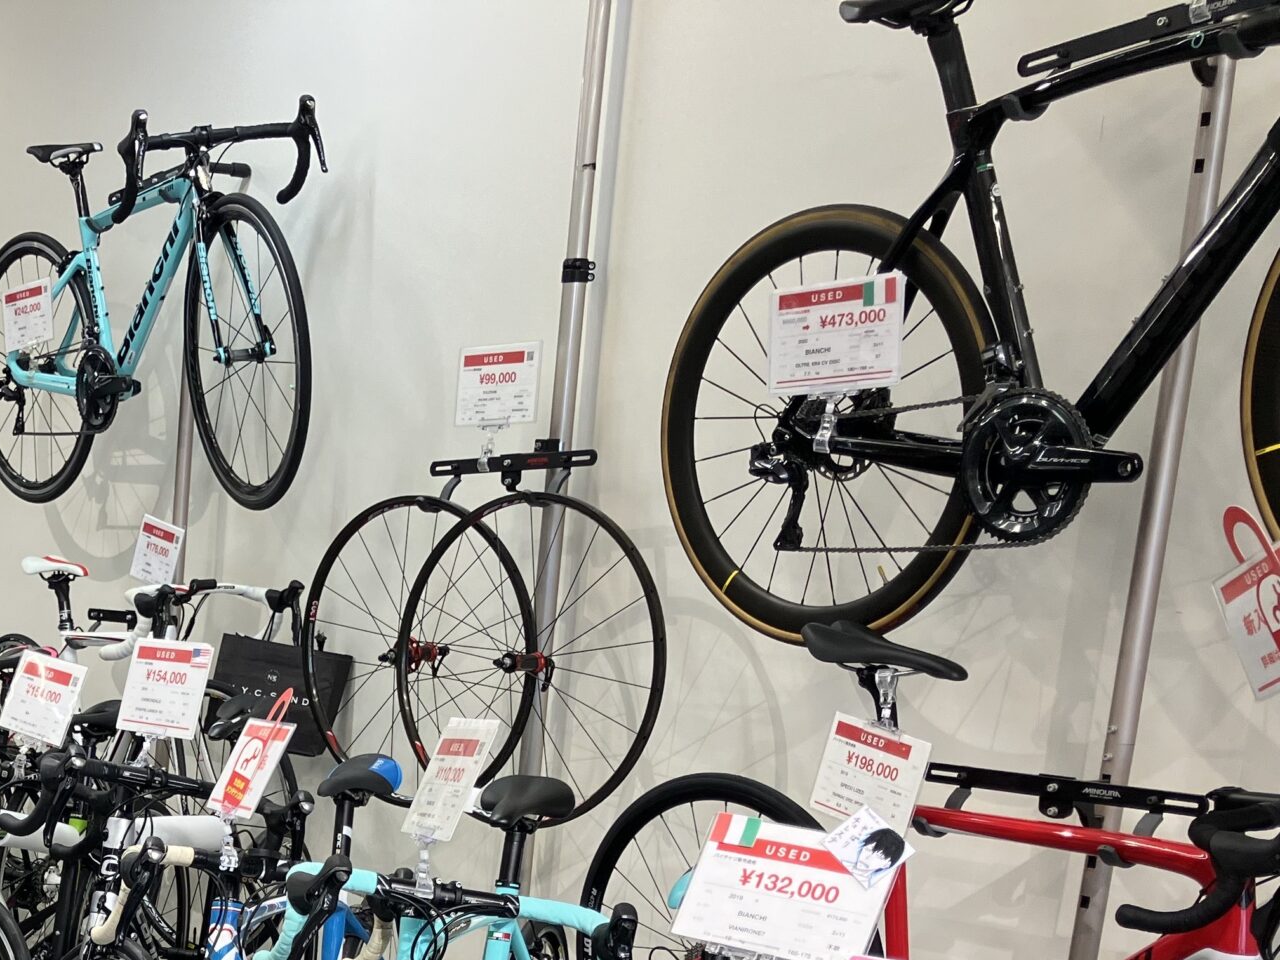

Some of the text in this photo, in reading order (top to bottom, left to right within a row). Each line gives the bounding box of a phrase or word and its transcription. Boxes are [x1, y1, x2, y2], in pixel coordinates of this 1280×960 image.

[811, 290, 843, 302] USED
[819, 308, 886, 329] ¥473,000
[483, 355, 504, 363] USED
[479, 371, 517, 386] ¥99,000
[1243, 562, 1270, 586] USED
[156, 650, 176, 659] USED
[146, 668, 188, 685] ¥154,000
[860, 733, 885, 748] USED
[846, 750, 899, 782] ¥198,000
[1081, 787, 1122, 798] MINOURA
[765, 845, 811, 862] USED
[738, 867, 840, 905] ¥132,000
[737, 909, 768, 922] BIANCHI
